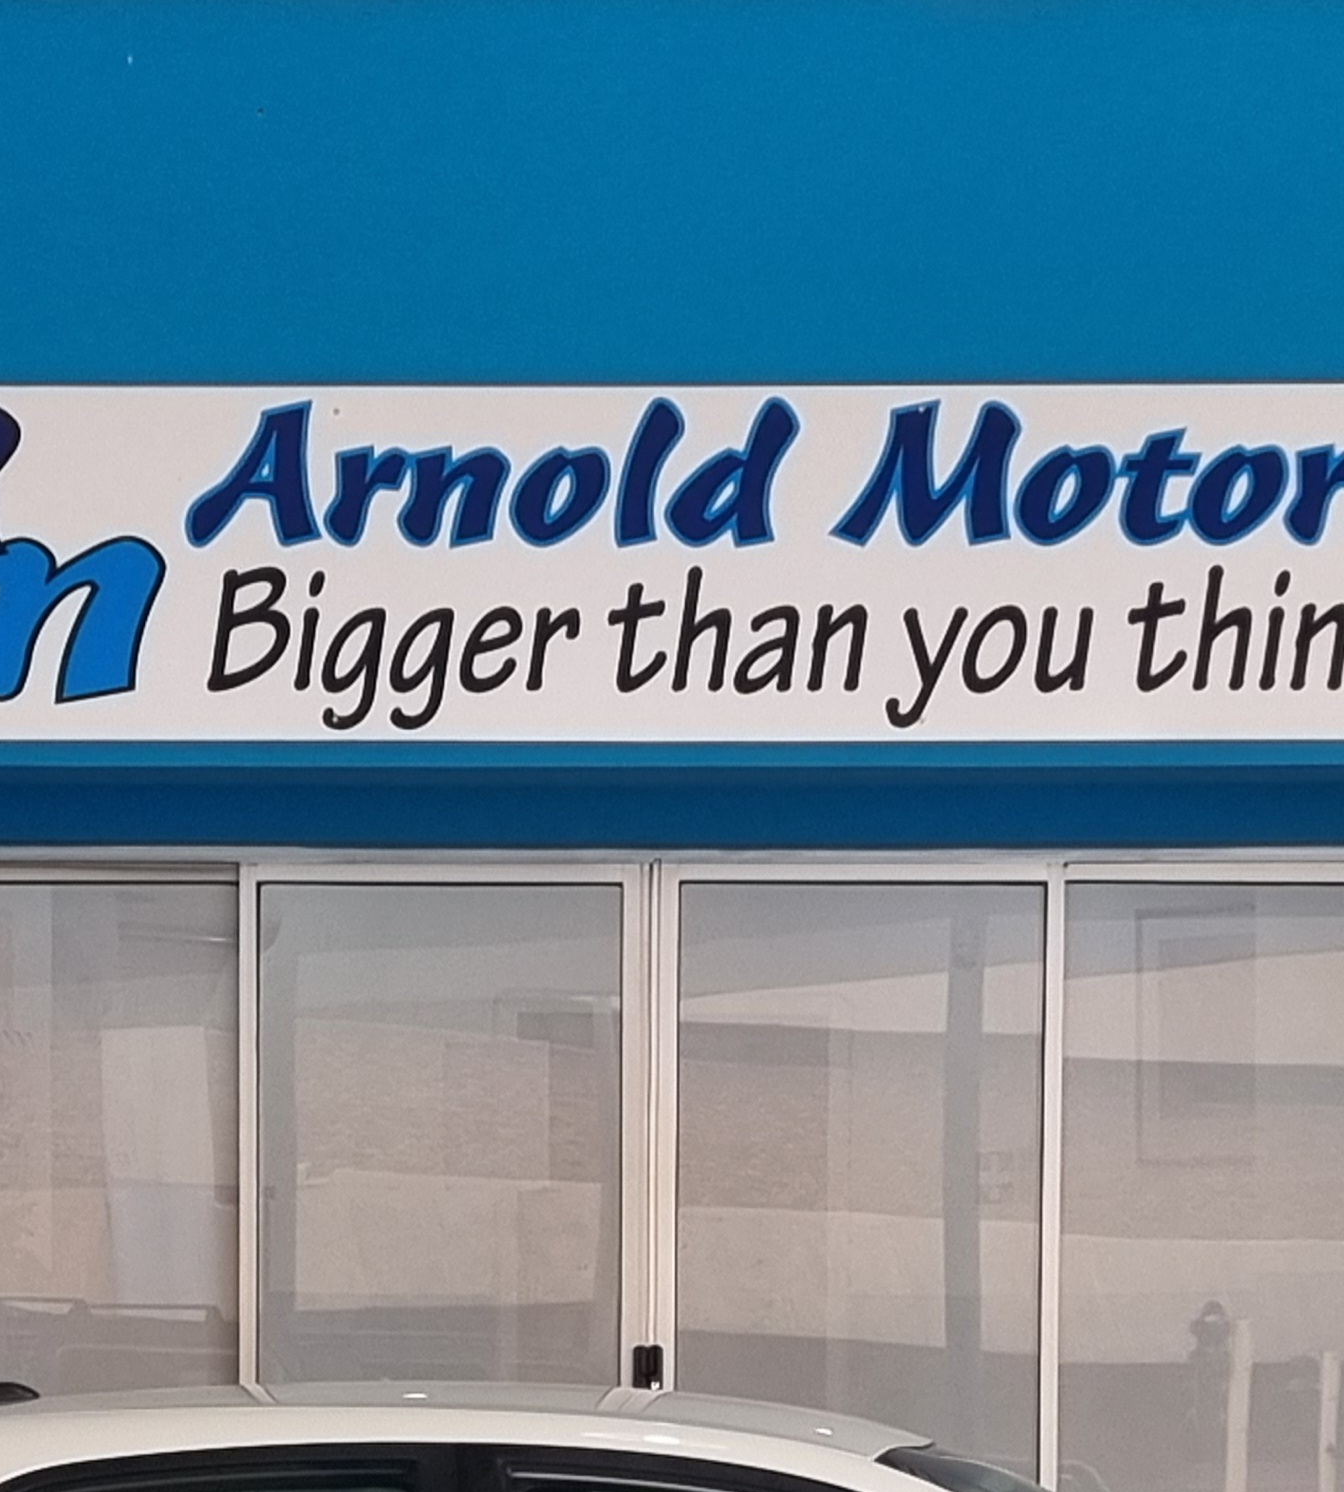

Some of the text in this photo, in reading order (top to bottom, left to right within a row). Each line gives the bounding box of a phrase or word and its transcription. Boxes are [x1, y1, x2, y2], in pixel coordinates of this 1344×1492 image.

[185, 396, 800, 548] Arnold
[207, 565, 581, 730] Bigger
[608, 565, 869, 694] than
[885, 605, 1094, 729] you
